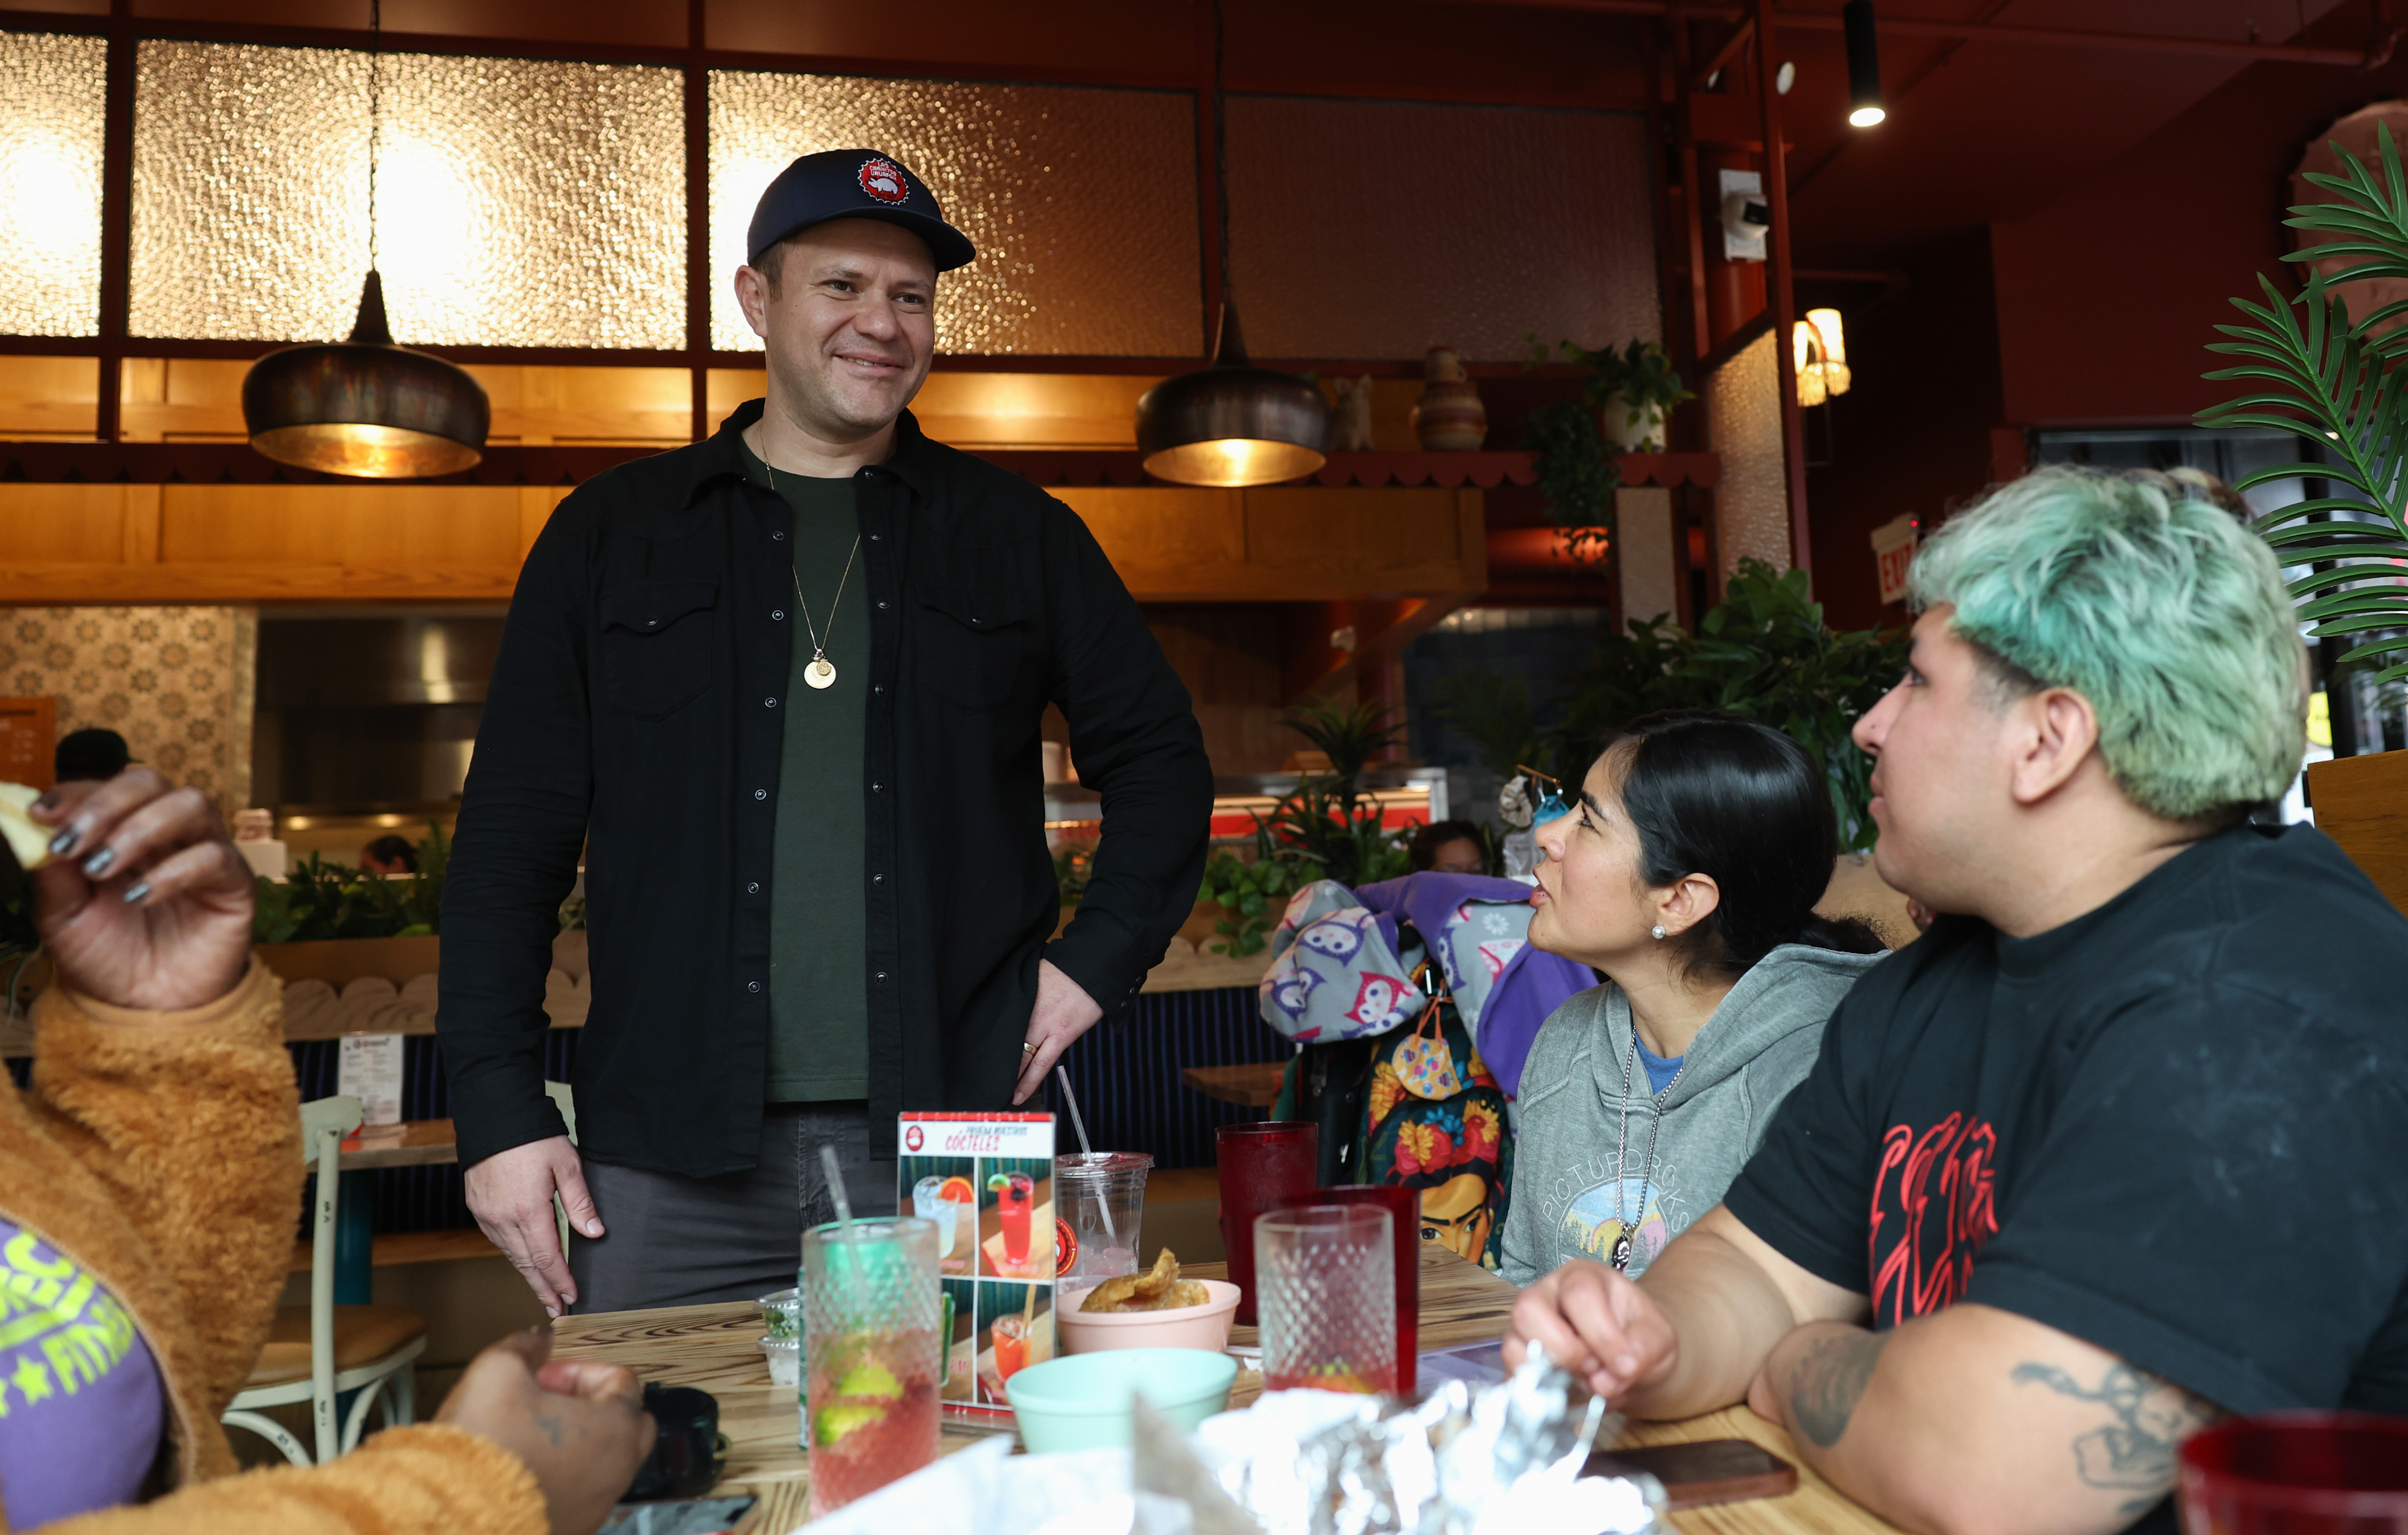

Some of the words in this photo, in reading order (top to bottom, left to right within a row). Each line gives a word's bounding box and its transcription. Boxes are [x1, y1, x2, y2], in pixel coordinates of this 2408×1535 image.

[870, 165, 896, 176] CARNITAS
[871, 170, 896, 180] URUAPAN
[1542, 1149, 1643, 1224] PICTURD
